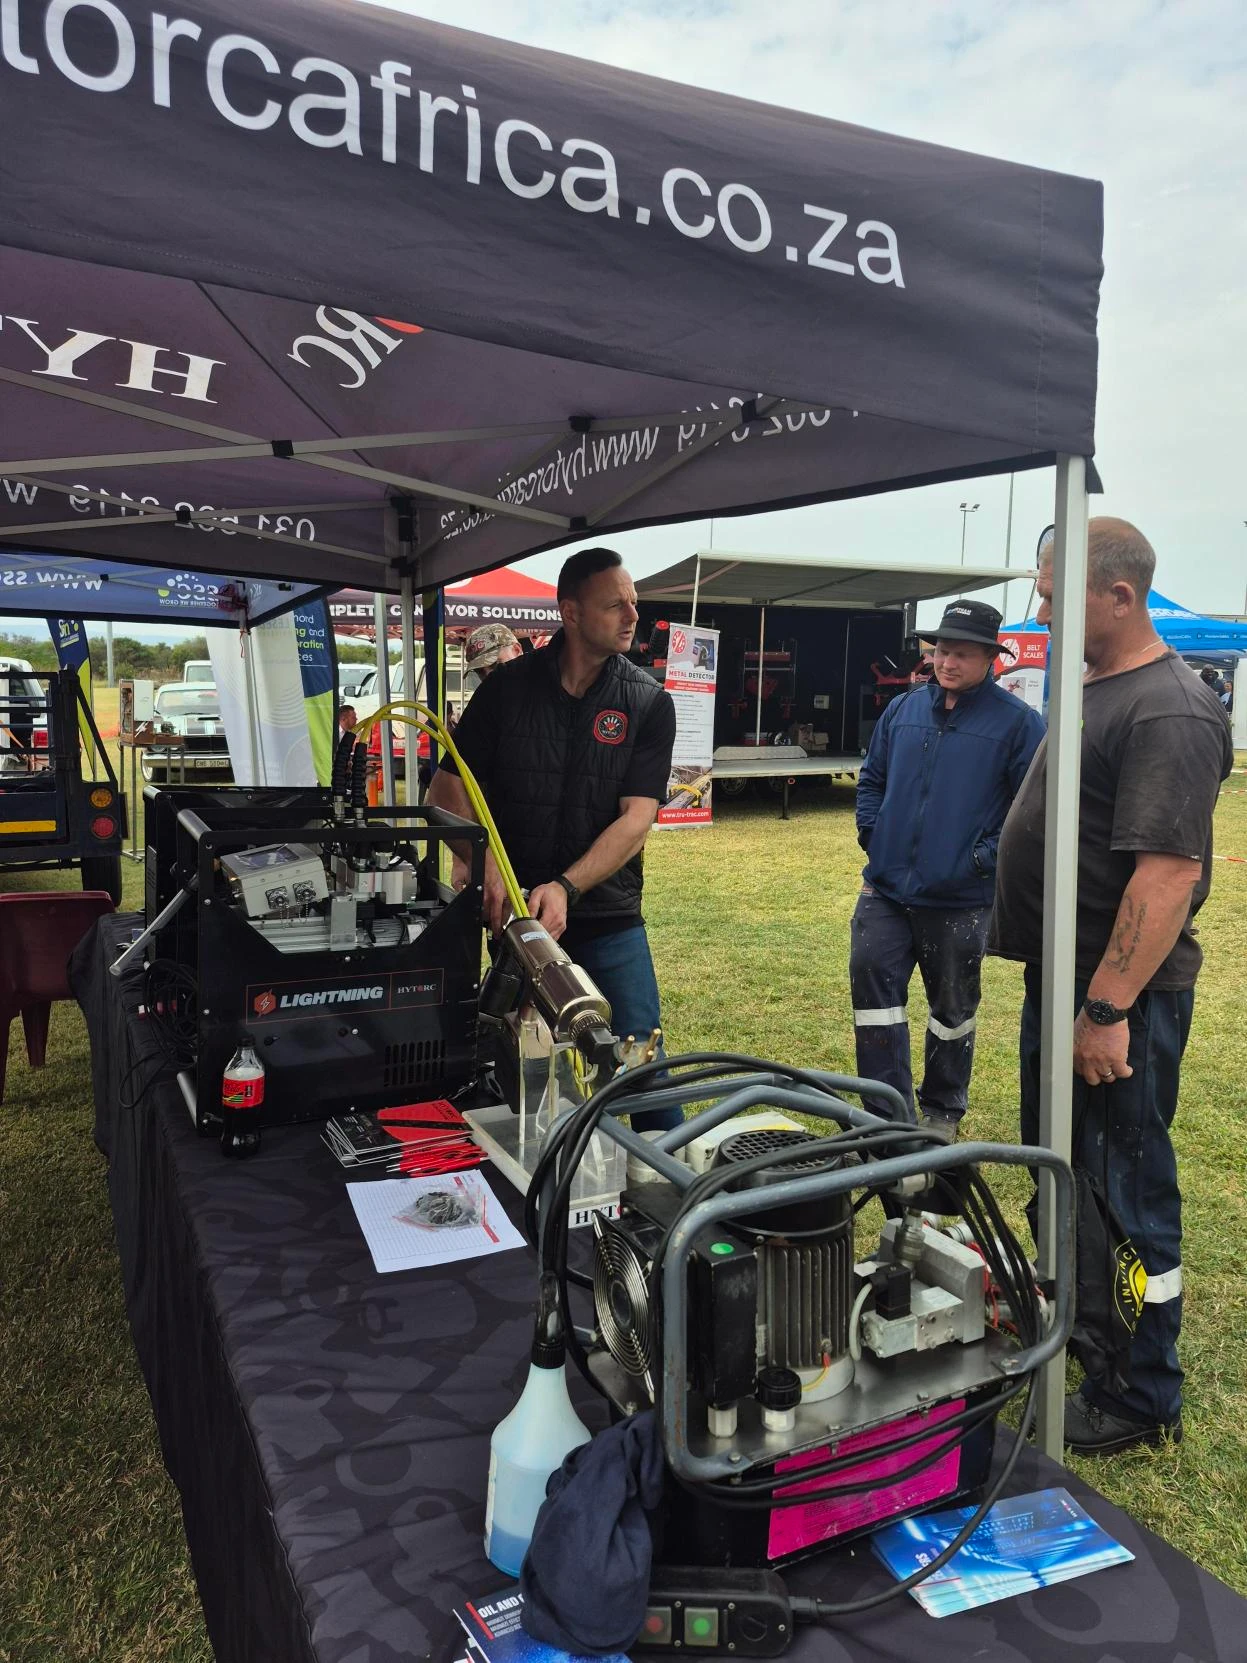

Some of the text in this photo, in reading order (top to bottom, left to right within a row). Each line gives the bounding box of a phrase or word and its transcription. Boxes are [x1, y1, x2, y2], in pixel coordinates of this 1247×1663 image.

[309, 628, 325, 637] and
[297, 640, 324, 649] ration
[668, 670, 715, 681] METAL DETECTOR
[279, 986, 384, 1008] LIGHTNING
[478, 1604, 499, 1619] OIL
[496, 1596, 520, 1612] AND
